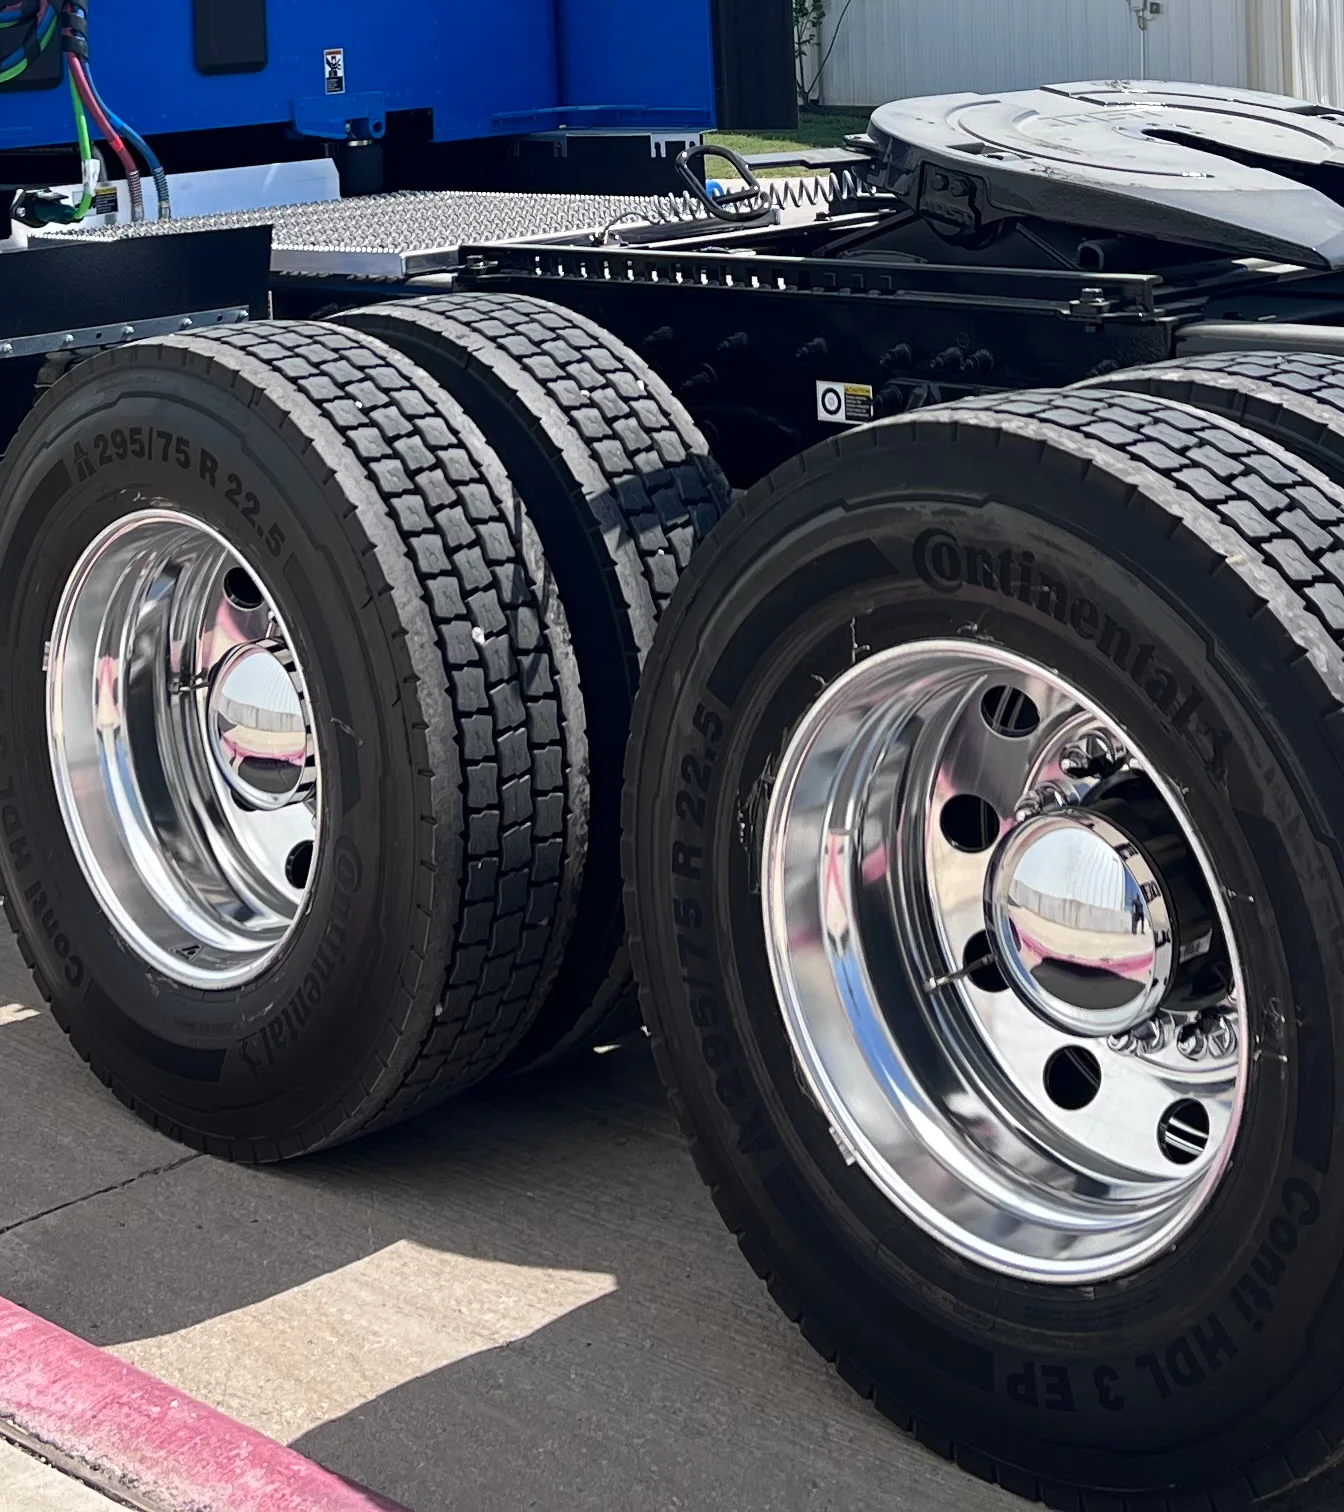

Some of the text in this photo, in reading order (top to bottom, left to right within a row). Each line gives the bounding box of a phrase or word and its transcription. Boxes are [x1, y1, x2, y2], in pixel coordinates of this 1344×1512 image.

[199, 447, 219, 488] R
[223, 472, 287, 557] 22.5
[912, 527, 1205, 727] Continental
[676, 698, 725, 831] 22.5
[671, 839, 703, 880] R
[1228, 1176, 1321, 1333] Conti
[1006, 1360, 1076, 1412] EP
[1093, 1363, 1126, 1412] 3
[1134, 1310, 1239, 1400] HDL
